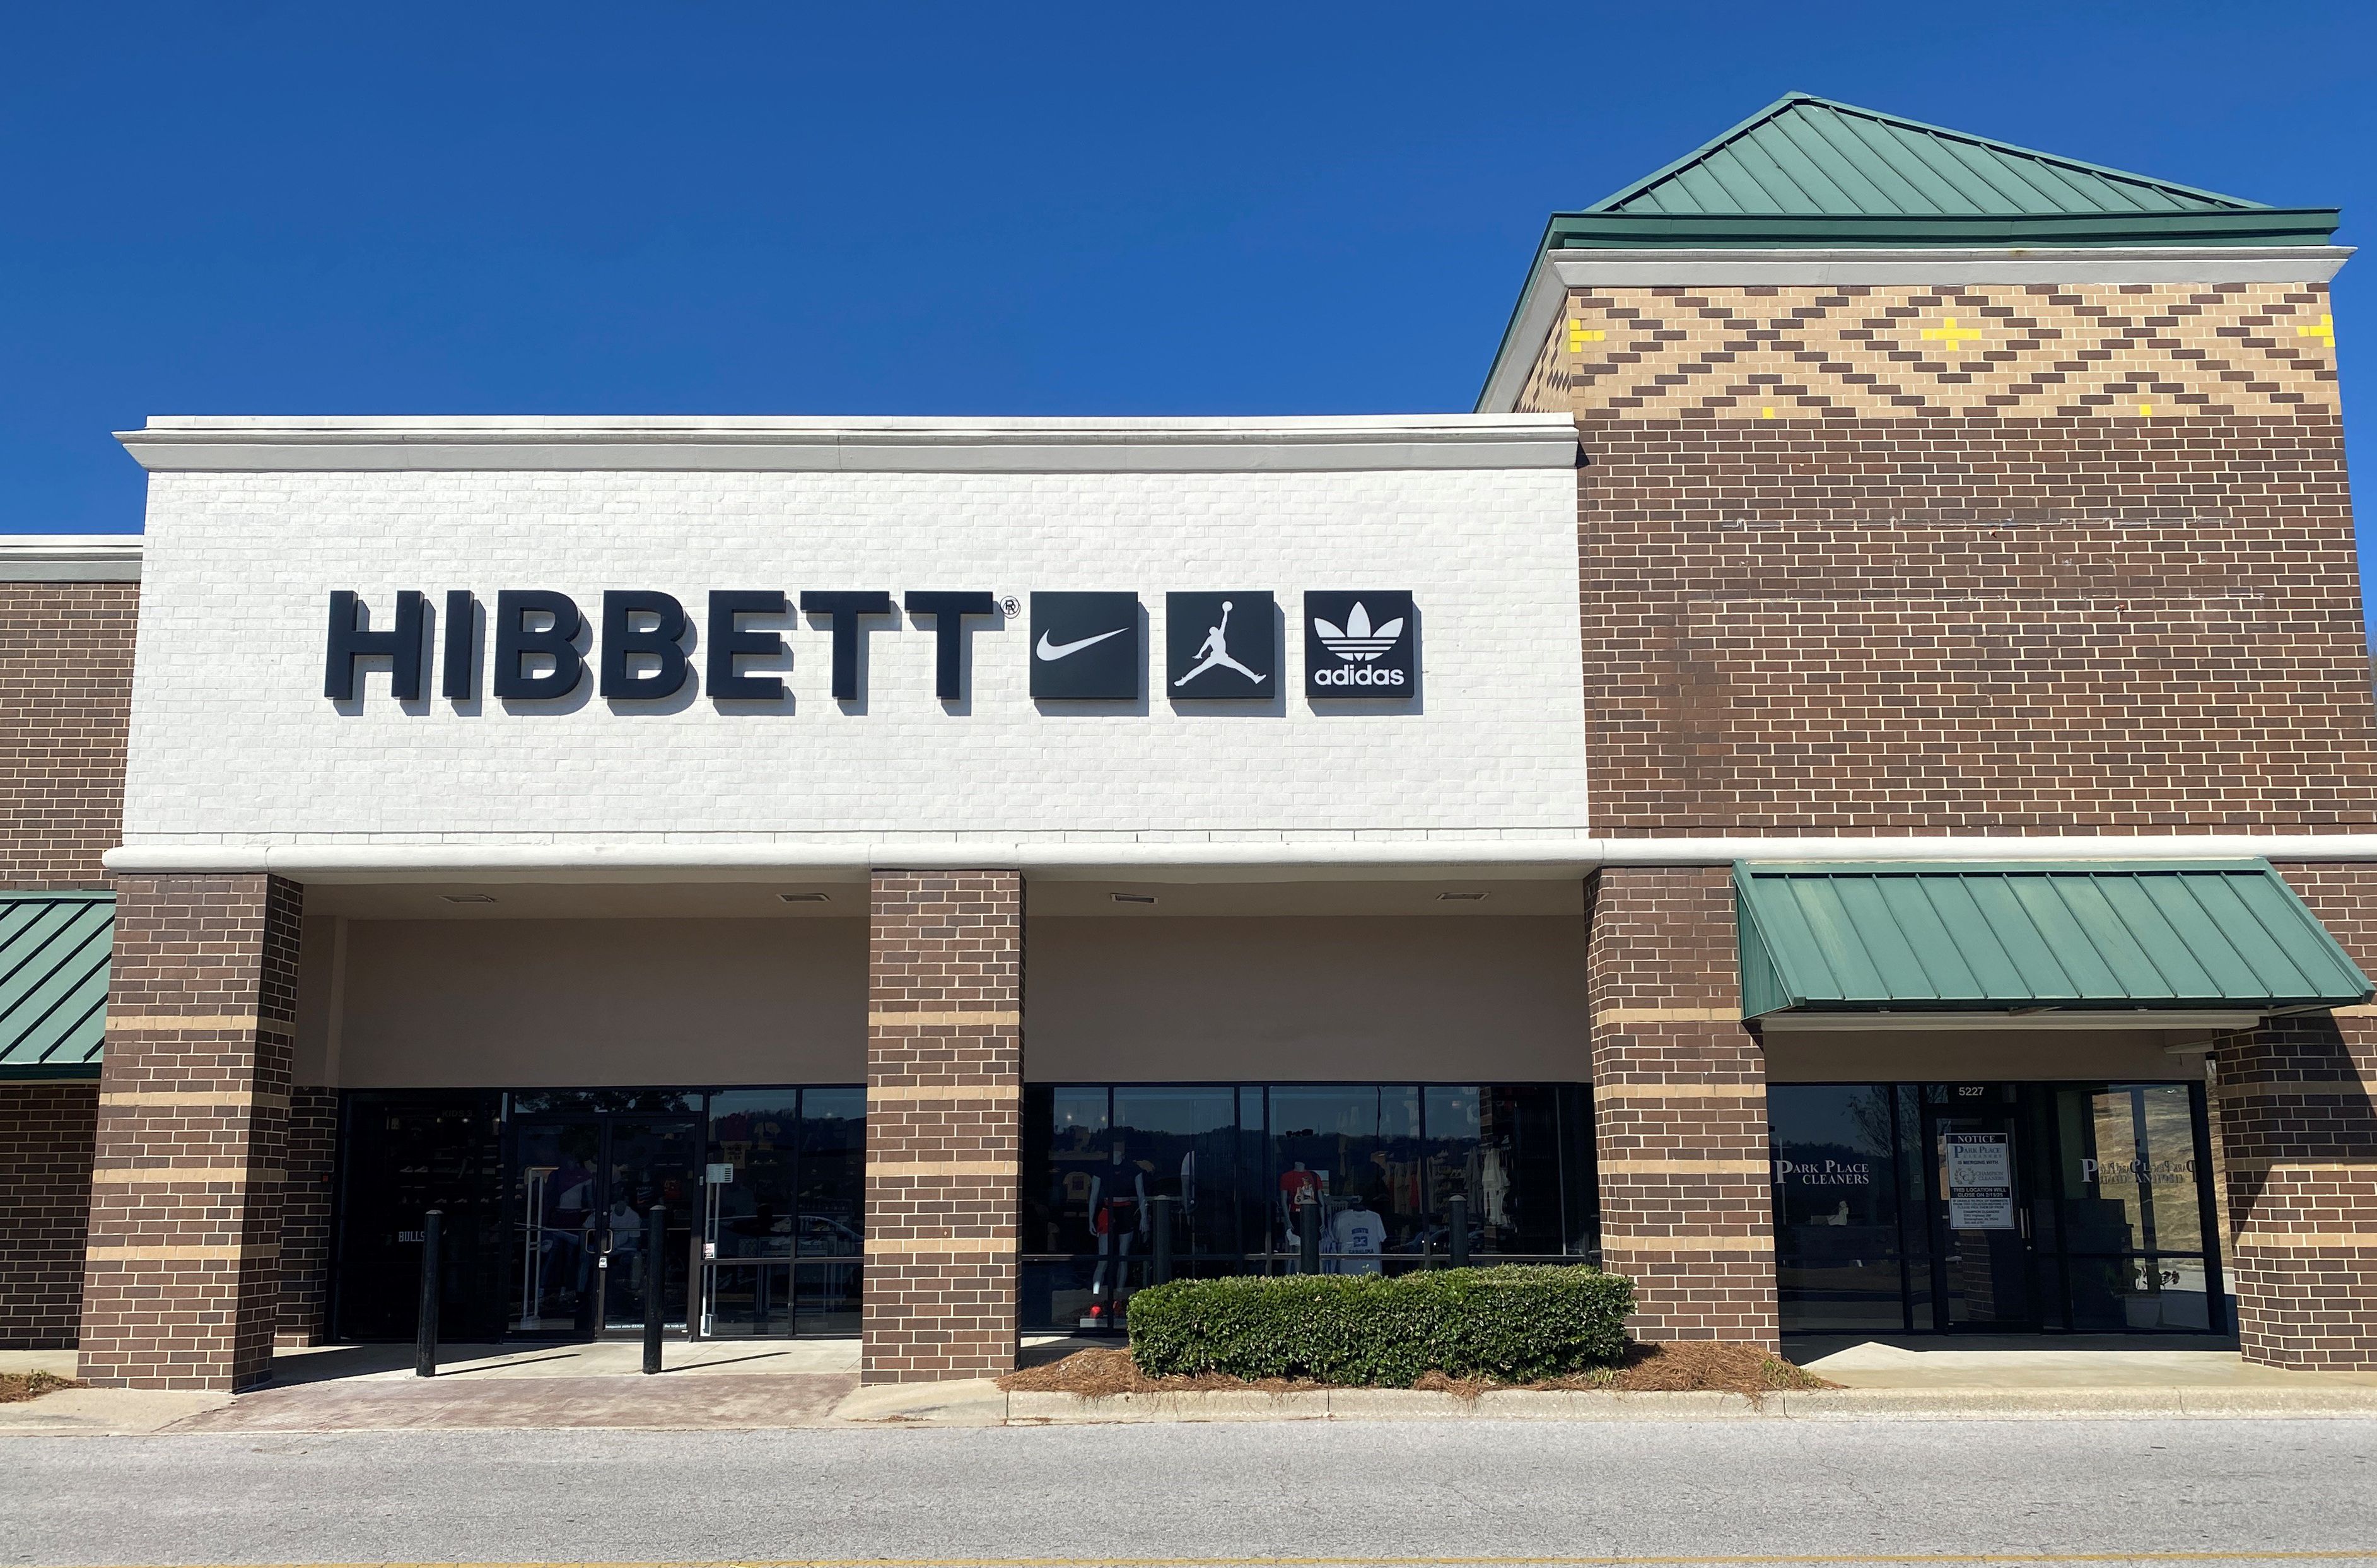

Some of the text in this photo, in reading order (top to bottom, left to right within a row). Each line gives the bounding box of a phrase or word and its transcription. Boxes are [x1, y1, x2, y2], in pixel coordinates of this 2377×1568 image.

[1314, 664, 1405, 686] adidas
[1958, 1086, 1984, 1096] 5227
[1957, 1135, 1996, 1143] NOTICE
[1953, 1145, 2002, 1158] PARK PLACE
[1773, 1159, 1869, 1184] PARK PLACE
[1802, 1174, 1869, 1185] CLEANERS
[398, 1231, 424, 1242] BULLS
[1353, 1236, 1368, 1247] 23
